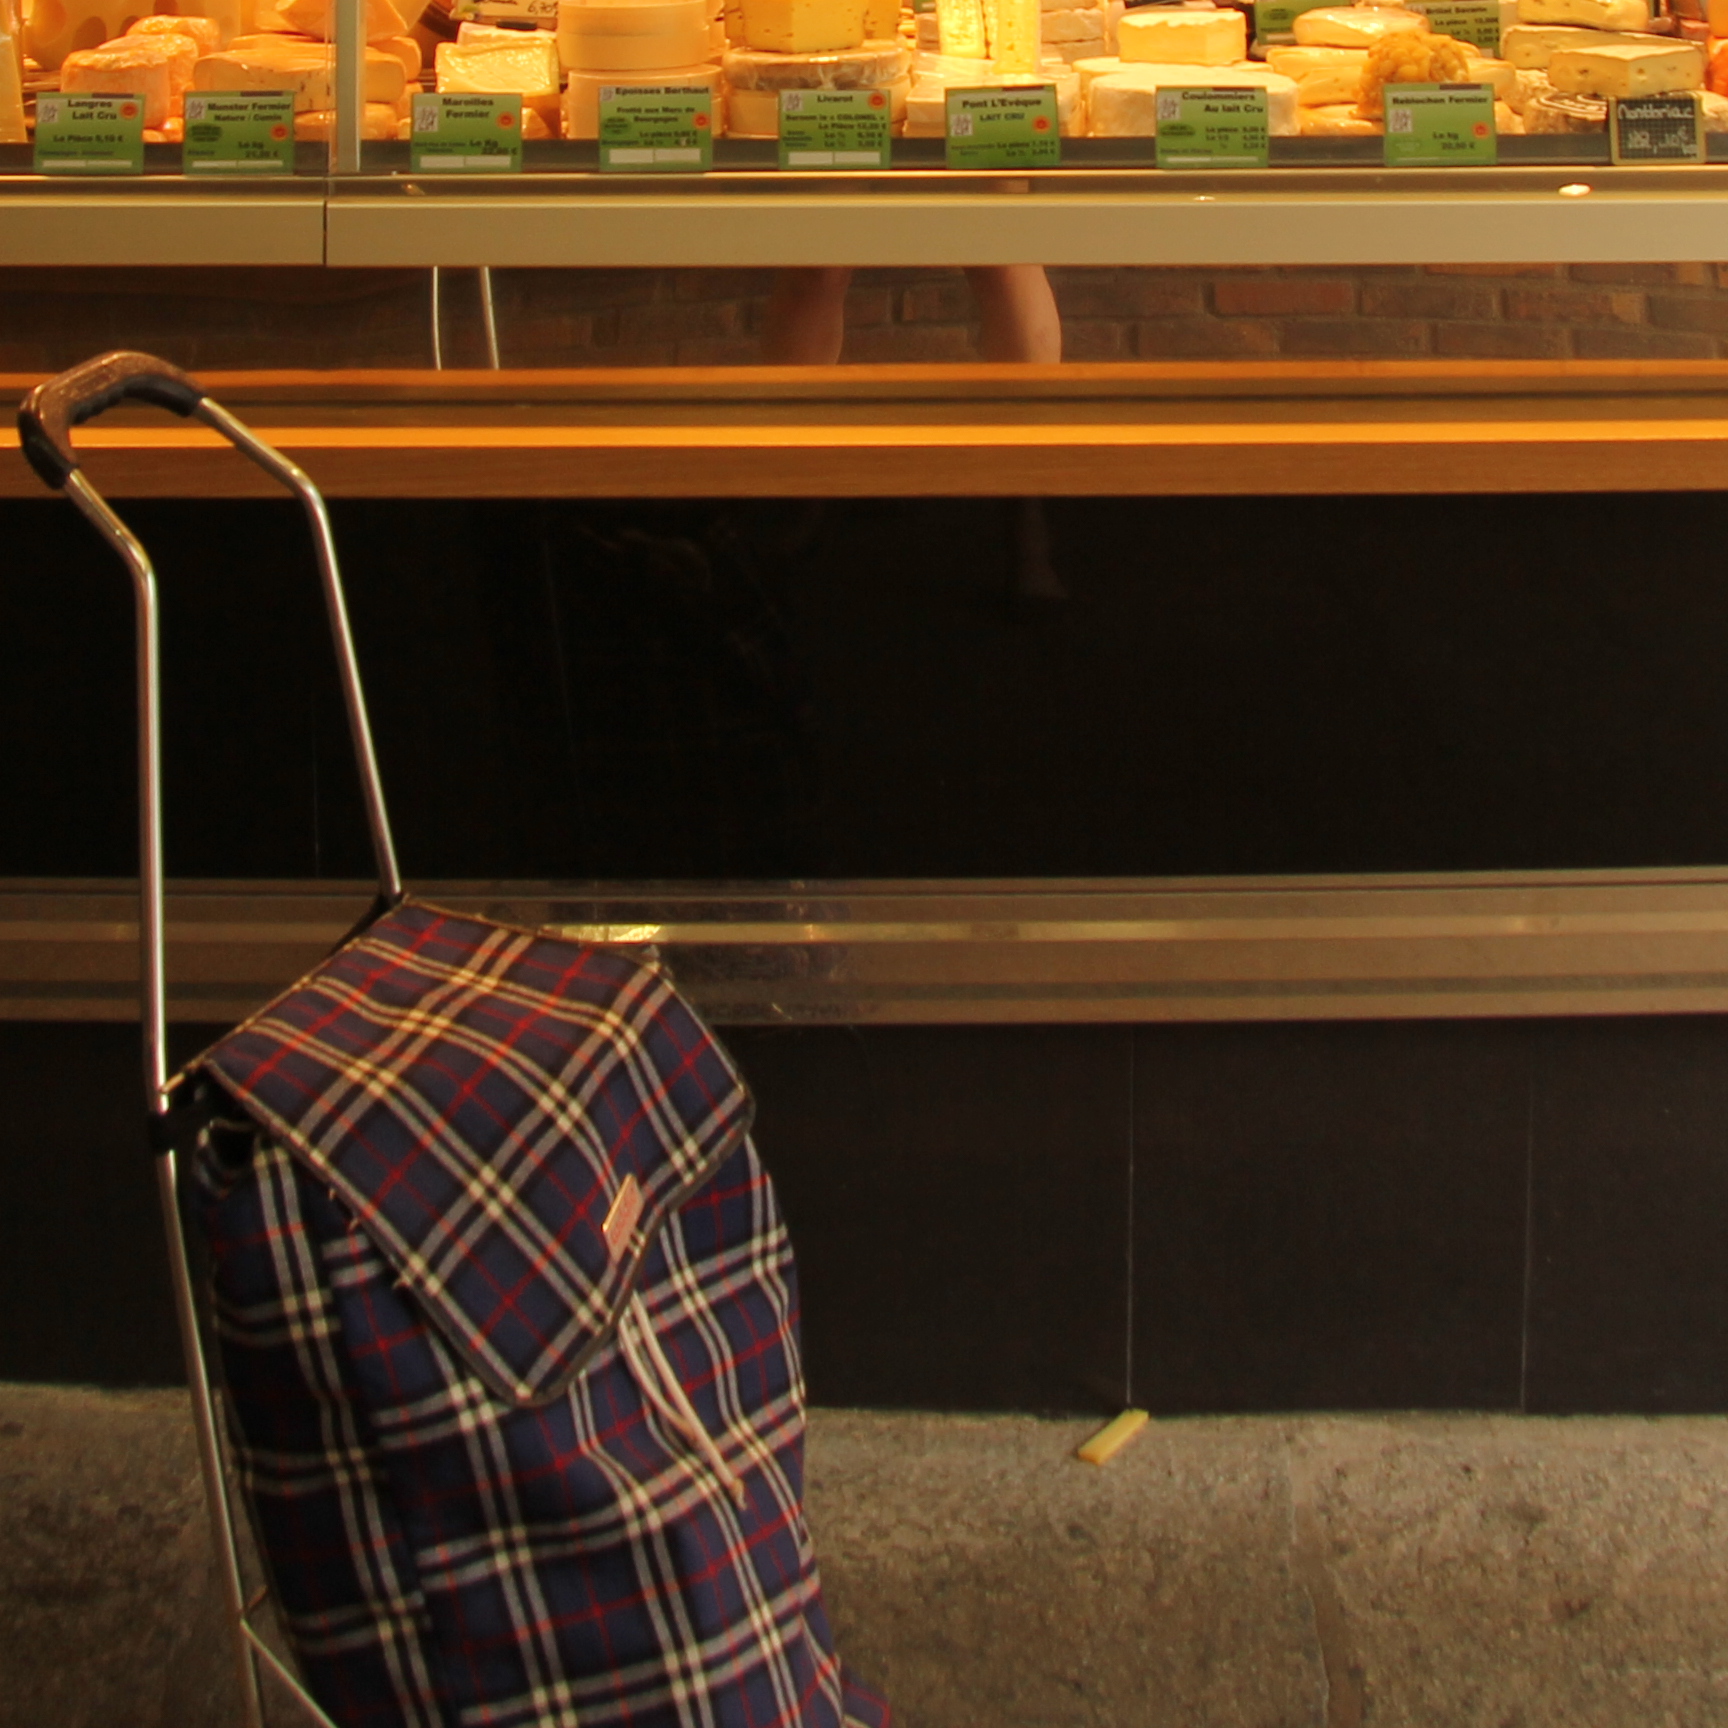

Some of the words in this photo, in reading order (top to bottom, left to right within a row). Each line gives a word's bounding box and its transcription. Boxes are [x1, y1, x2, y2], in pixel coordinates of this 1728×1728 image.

[817, 94, 854, 103] Livarot
[1182, 92, 1255, 101] Coulommiers
[68, 99, 113, 109] Langres
[208, 102, 248, 112] Munster
[252, 101, 291, 111] Fermier
[442, 97, 494, 107] Maroilles
[962, 99, 988, 109] Pont
[1204, 104, 1219, 113] Au
[1244, 104, 1264, 113] Cru
[72, 111, 94, 121] Lait
[98, 111, 117, 120] Cru
[446, 109, 490, 119] Fermier
